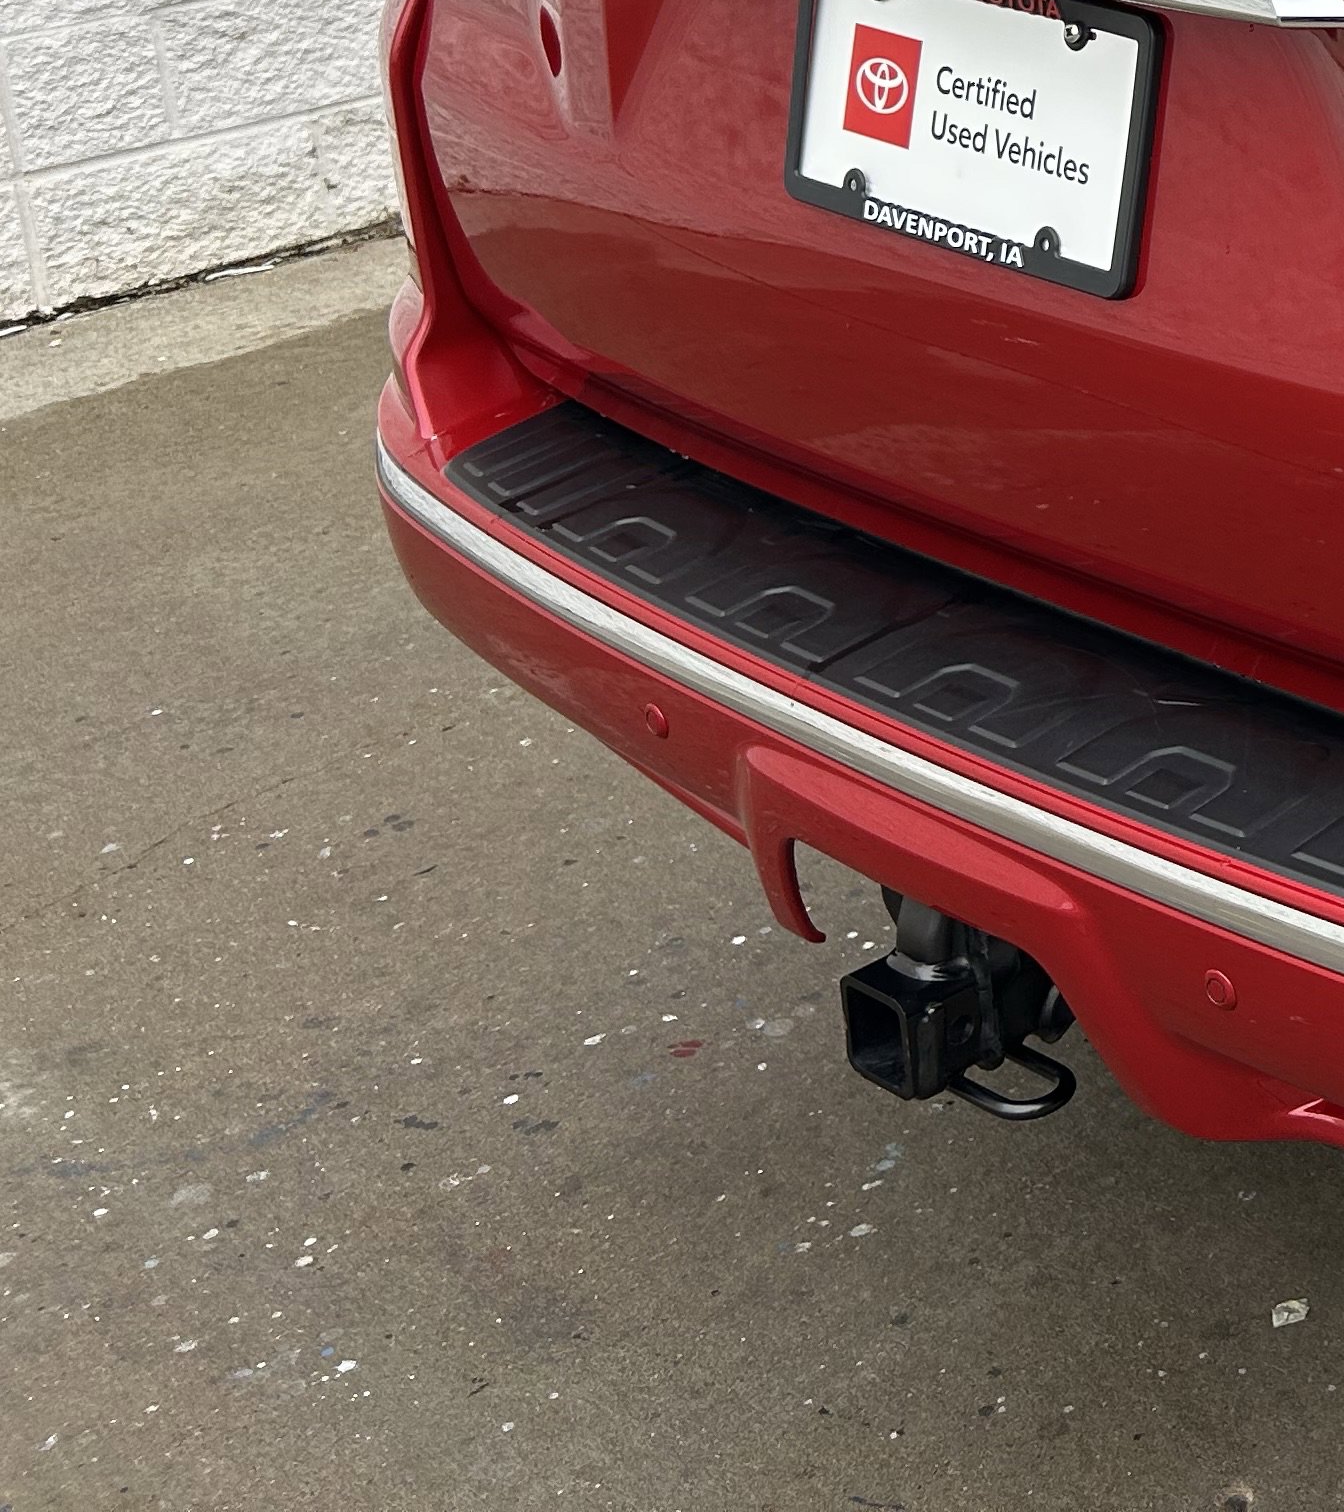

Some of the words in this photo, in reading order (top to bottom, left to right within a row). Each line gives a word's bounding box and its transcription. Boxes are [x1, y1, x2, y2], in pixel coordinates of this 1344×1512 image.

[936, 66, 1036, 120] Certified
[931, 110, 988, 154] Used
[995, 128, 1089, 185] Vehicles
[863, 199, 994, 262] DAVENPORT,
[999, 242, 1023, 268] IA
